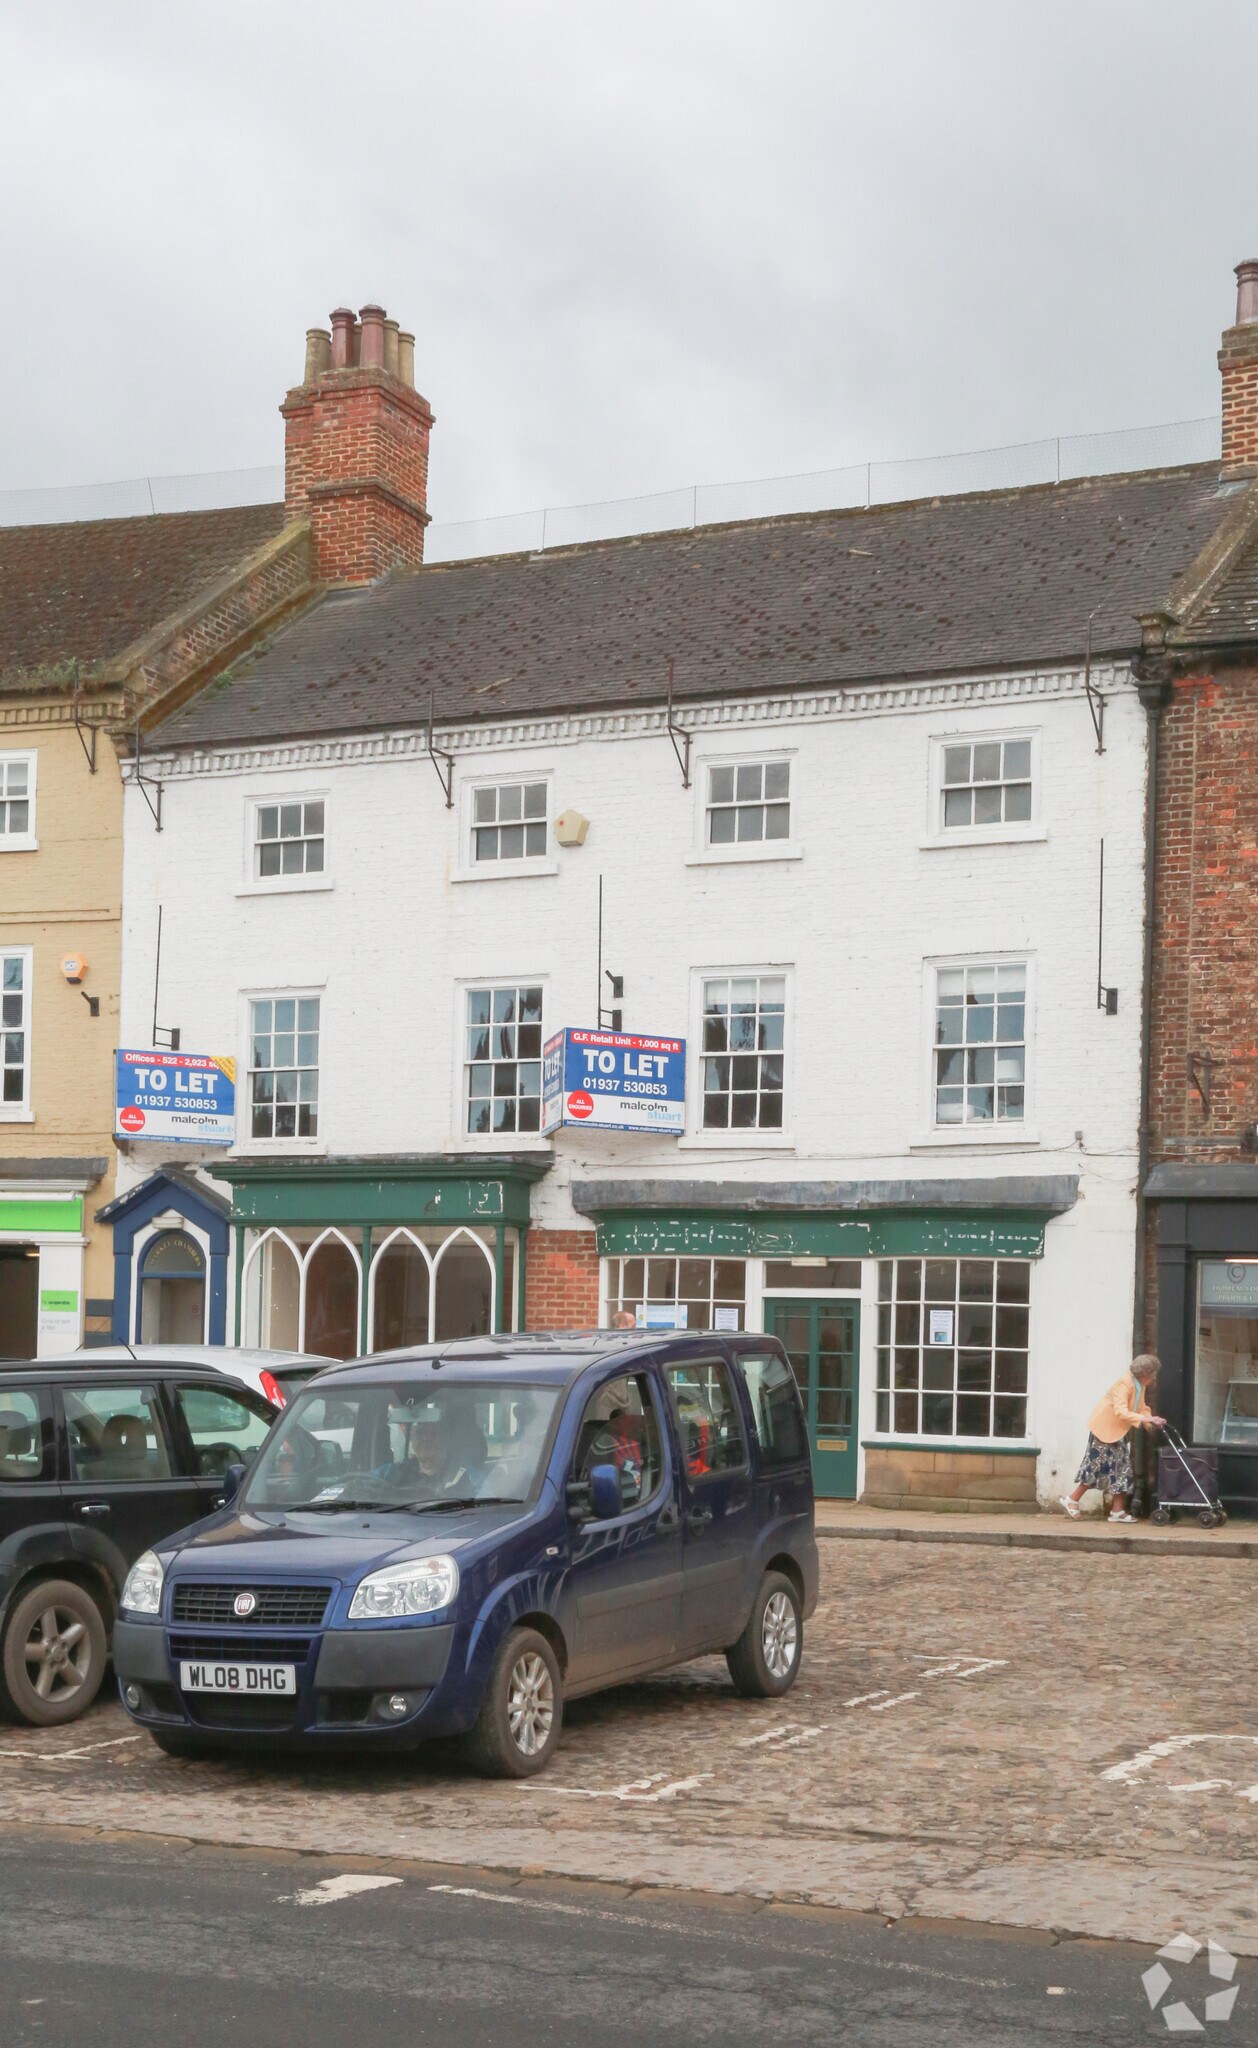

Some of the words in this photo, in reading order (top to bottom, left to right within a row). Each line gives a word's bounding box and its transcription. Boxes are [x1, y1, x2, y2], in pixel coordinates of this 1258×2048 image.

[574, 1033, 588, 1042] G.F.
[590, 1035, 612, 1044] Retail
[615, 1037, 631, 1046] Unit
[638, 1040, 658, 1048] 1,000
[660, 1043, 670, 1051] sq
[672, 1042, 678, 1050] ft
[126, 1054, 156, 1063] Offices
[185, 1058, 206, 1067] 2,923
[583, 1049, 616, 1074] TO
[624, 1053, 669, 1078] LET
[134, 1068, 168, 1090] TO
[175, 1072, 218, 1094] LET
[583, 1077, 620, 1091] 01937
[624, 1080, 668, 1096] 530853
[134, 1094, 171, 1106] 01937
[174, 1098, 218, 1110] 530853
[620, 1101, 668, 1112] malcolm
[172, 1116, 218, 1126] malcolm
[648, 1111, 681, 1121] stuart
[198, 1124, 232, 1133] stuart
[188, 1666, 240, 1688] WL08
[246, 1668, 286, 1690] DHG
